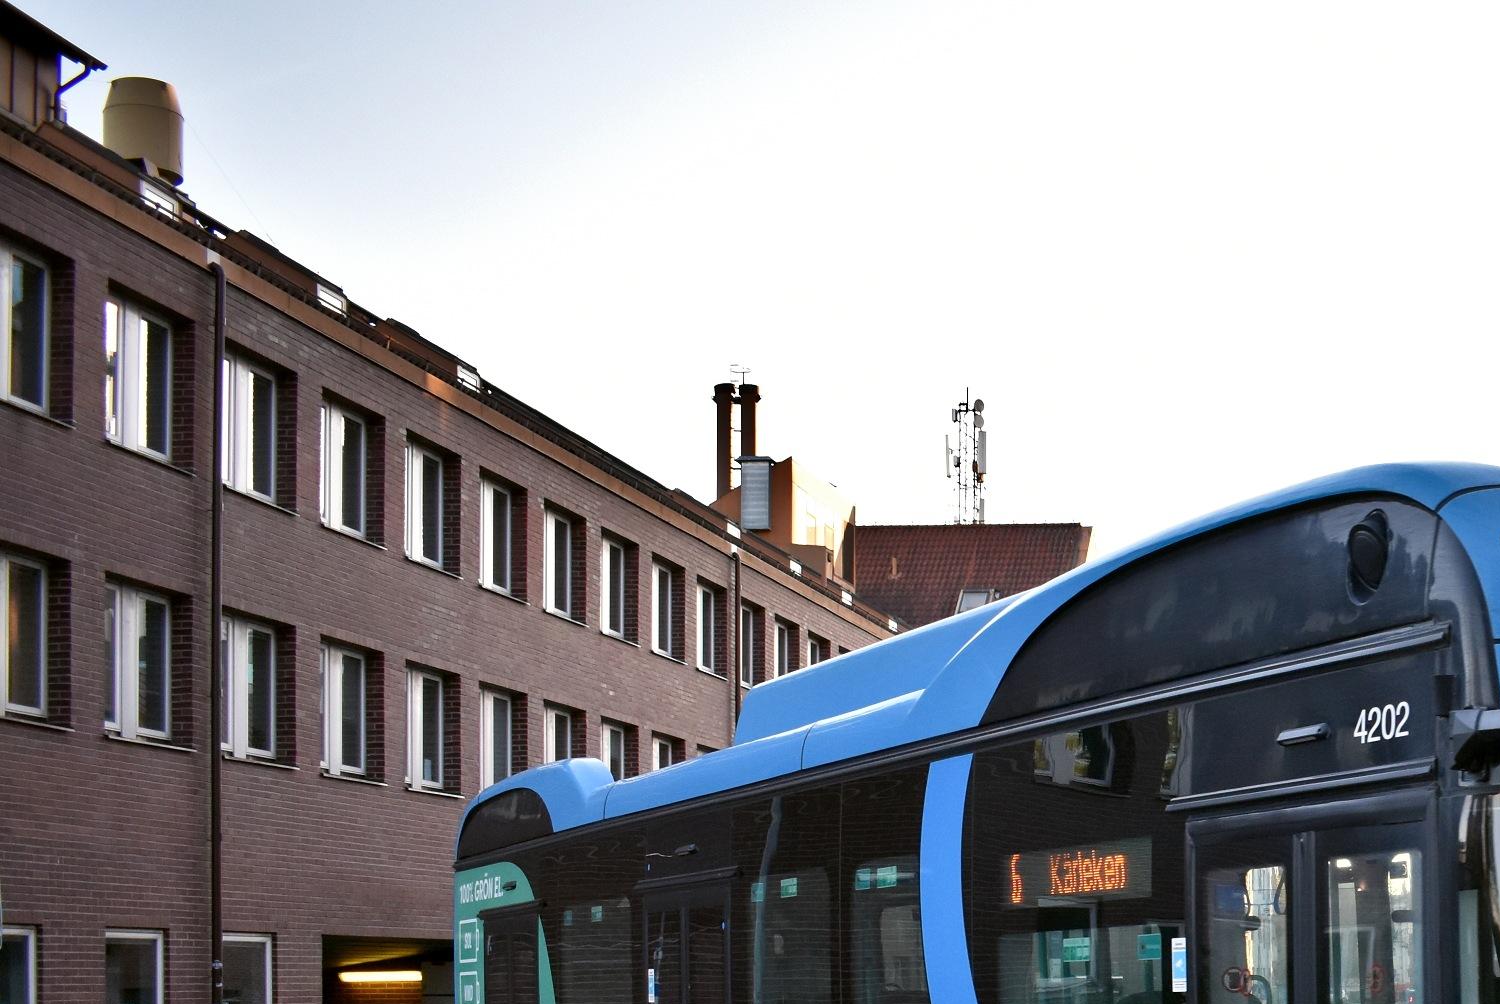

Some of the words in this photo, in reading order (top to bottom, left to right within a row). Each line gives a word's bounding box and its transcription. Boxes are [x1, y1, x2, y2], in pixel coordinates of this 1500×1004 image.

[1353, 701, 1410, 744] 4202
[460, 882, 474, 904] 100%
[474, 873, 494, 901] GRÖN
[1011, 853, 1022, 903] 6
[1049, 849, 1126, 895] Kärleken
